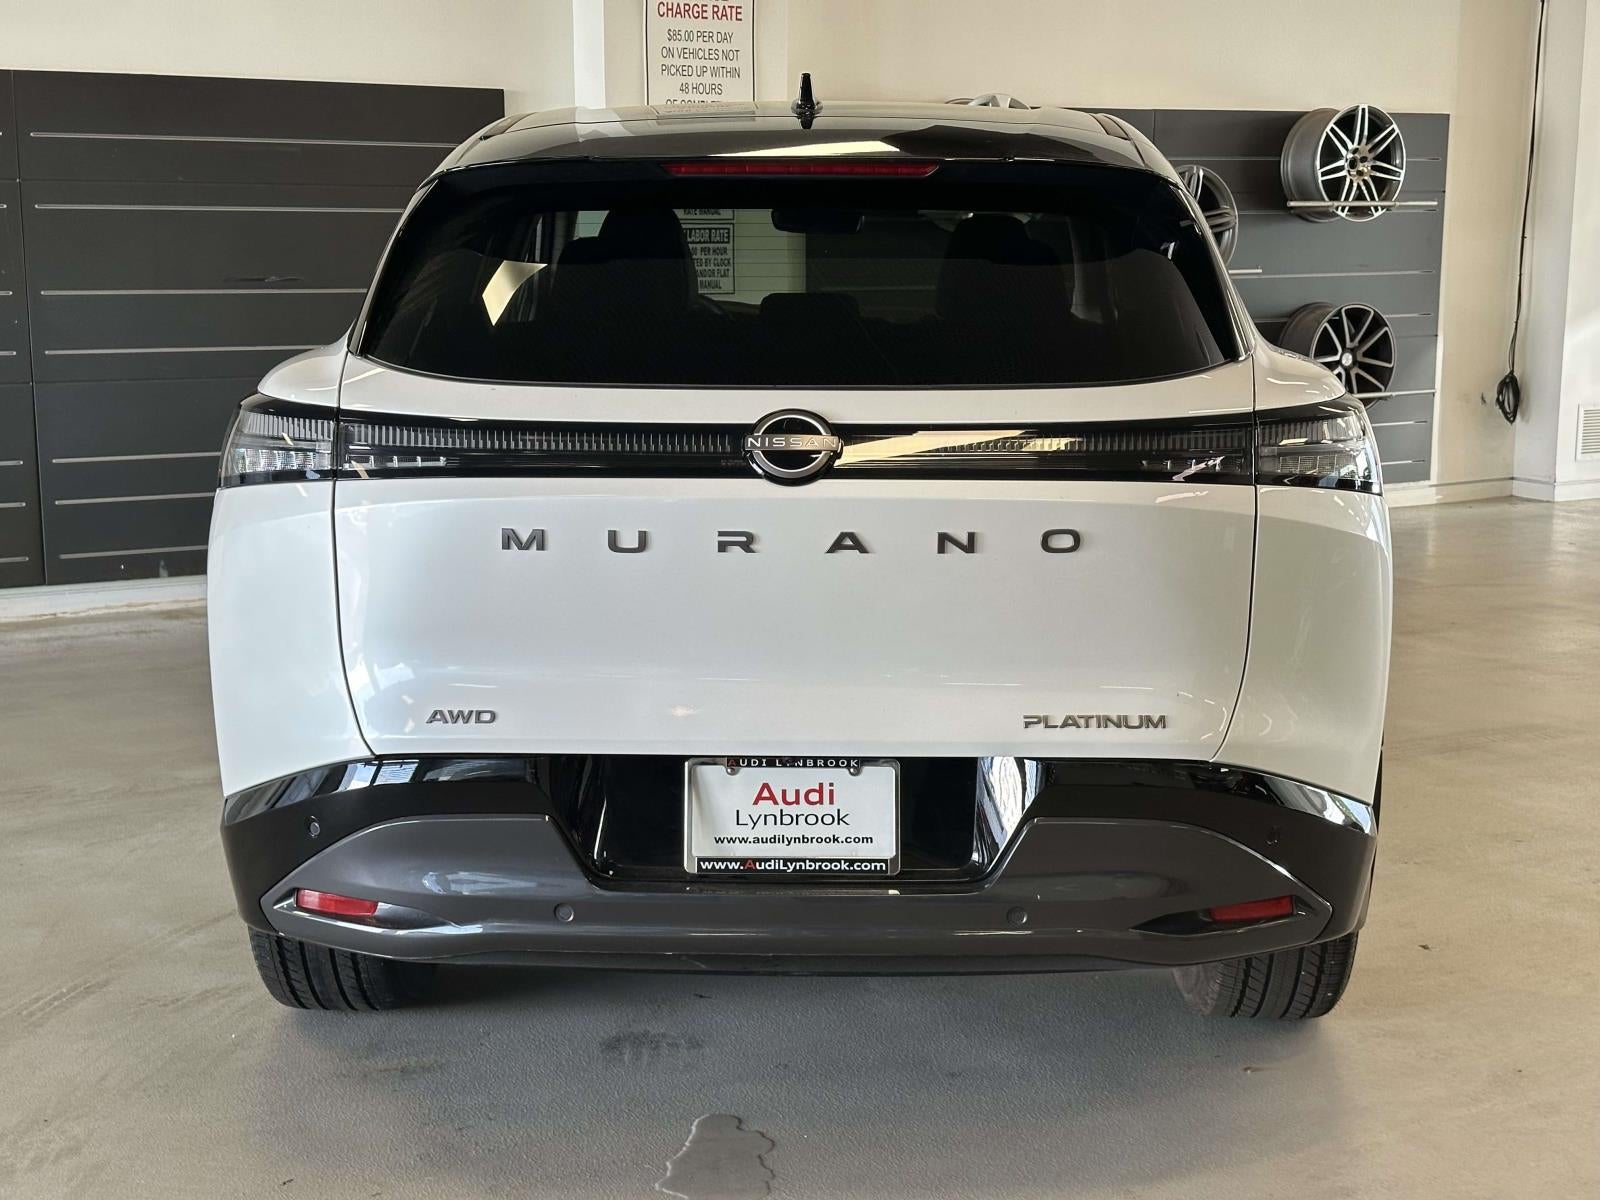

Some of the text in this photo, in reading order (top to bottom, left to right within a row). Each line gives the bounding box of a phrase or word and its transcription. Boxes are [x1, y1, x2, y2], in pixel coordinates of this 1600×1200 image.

[658, 2, 743, 21] CHARGE RATE
[667, 28, 733, 44] $85.00 PER DAY
[661, 46, 740, 62] ON VEHICLES NOT
[661, 64, 741, 79] PICKED UP WITHIN
[679, 82, 723, 95] 48 HOURS
[687, 229, 729, 241] LABOR RATE
[700, 246, 711, 256] PER
[712, 246, 728, 256] HOUR
[747, 437, 836, 448] NISSAN
[501, 527, 1081, 554] MURANO
[425, 709, 497, 725] AWD
[1023, 714, 1167, 730] PLATINUM
[728, 758, 768, 767] AUDI
[752, 782, 835, 806] Audi
[736, 809, 850, 830] Lynbrook
[714, 834, 874, 847] www.audilynbrook.com
[700, 859, 887, 873] www.AudiLynbrook.com
